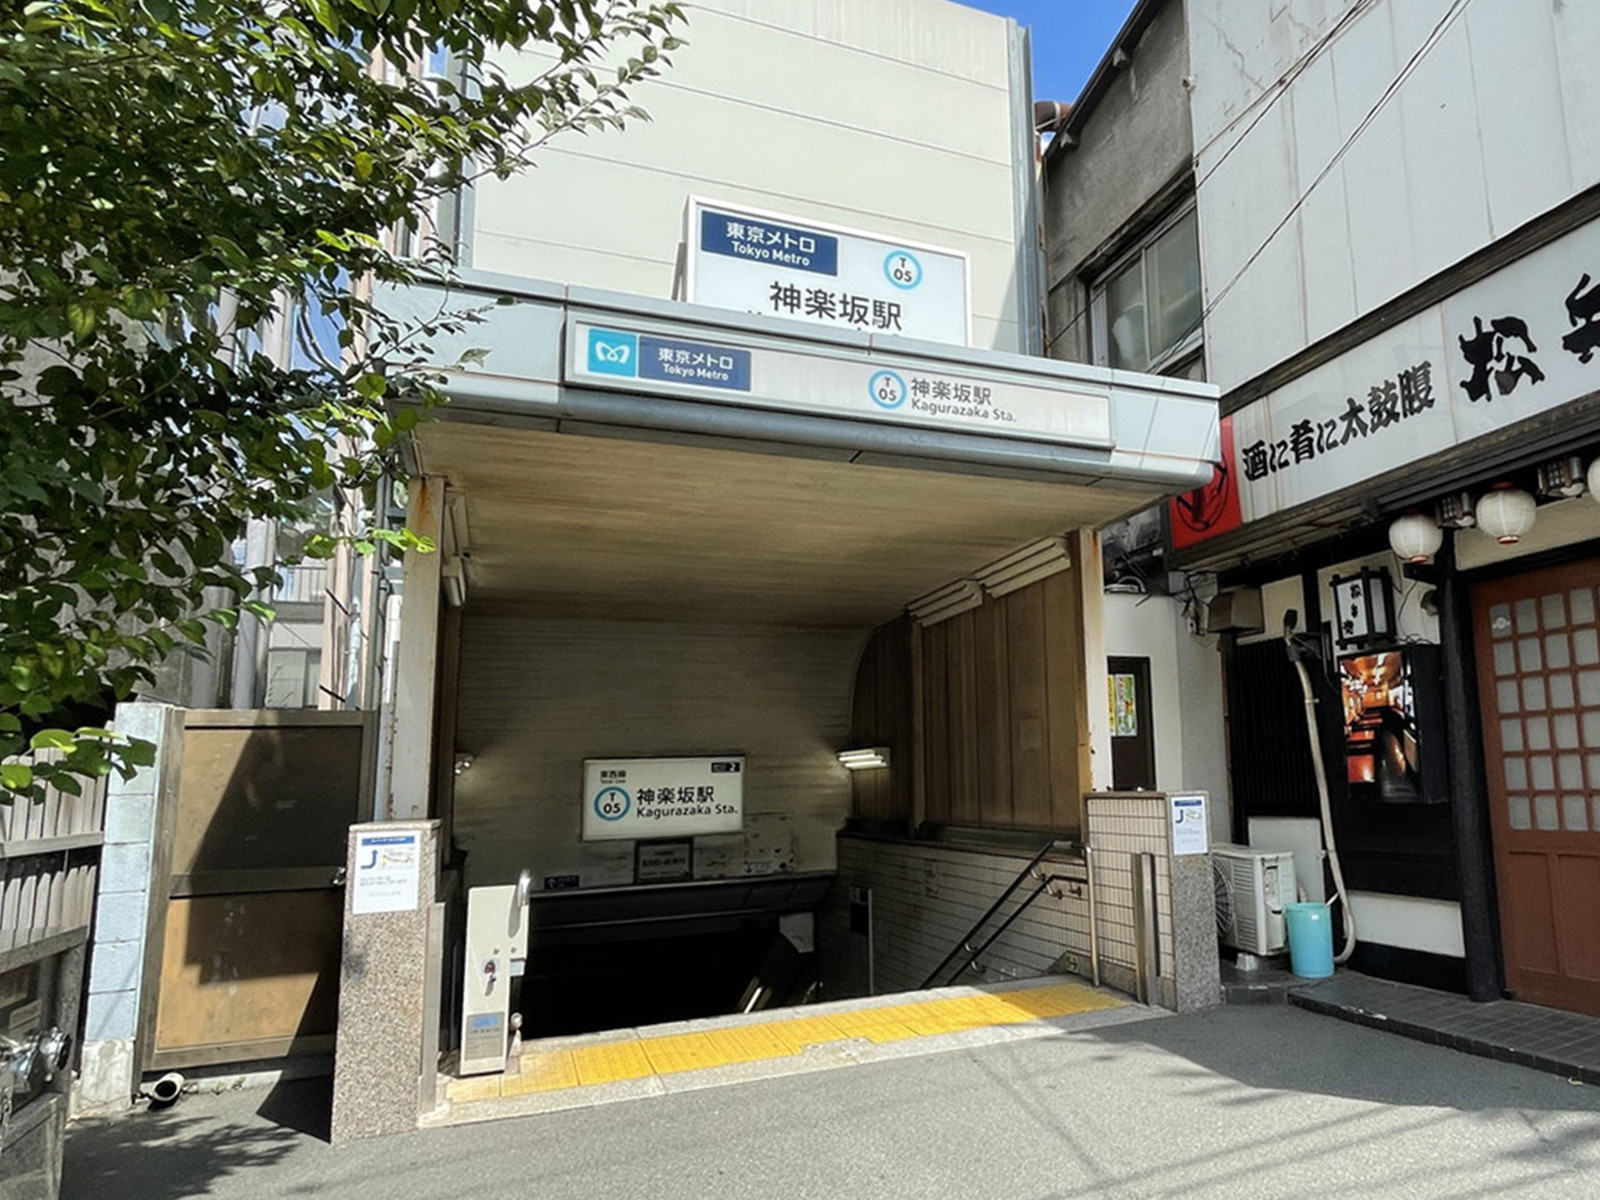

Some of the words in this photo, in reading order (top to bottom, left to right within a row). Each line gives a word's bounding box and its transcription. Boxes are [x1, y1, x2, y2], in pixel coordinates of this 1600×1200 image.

[726, 221, 816, 254] 東京メトロ
[731, 240, 770, 260] Tokyo
[772, 248, 811, 267] Metro
[898, 257, 907, 269] T
[893, 268, 913, 283] 05
[769, 280, 903, 331] 神楽坂駅
[658, 347, 734, 370] 東京メトロ
[662, 362, 695, 378] Tokyo
[696, 367, 729, 381] Metro
[884, 376, 891, 388] T
[911, 377, 993, 405] 神楽坂駅
[878, 388, 897, 402] 05
[911, 398, 990, 420] Kagurazaka
[992, 408, 1017, 423] Sta.
[1241, 360, 1436, 482] 酒に肴に太鼓腹
[609, 792, 616, 802] T
[636, 786, 715, 806] 神楽坂駅
[603, 802, 621, 815] 05
[636, 804, 712, 820] Kagurazaka
[714, 802, 739, 816] Sta.
